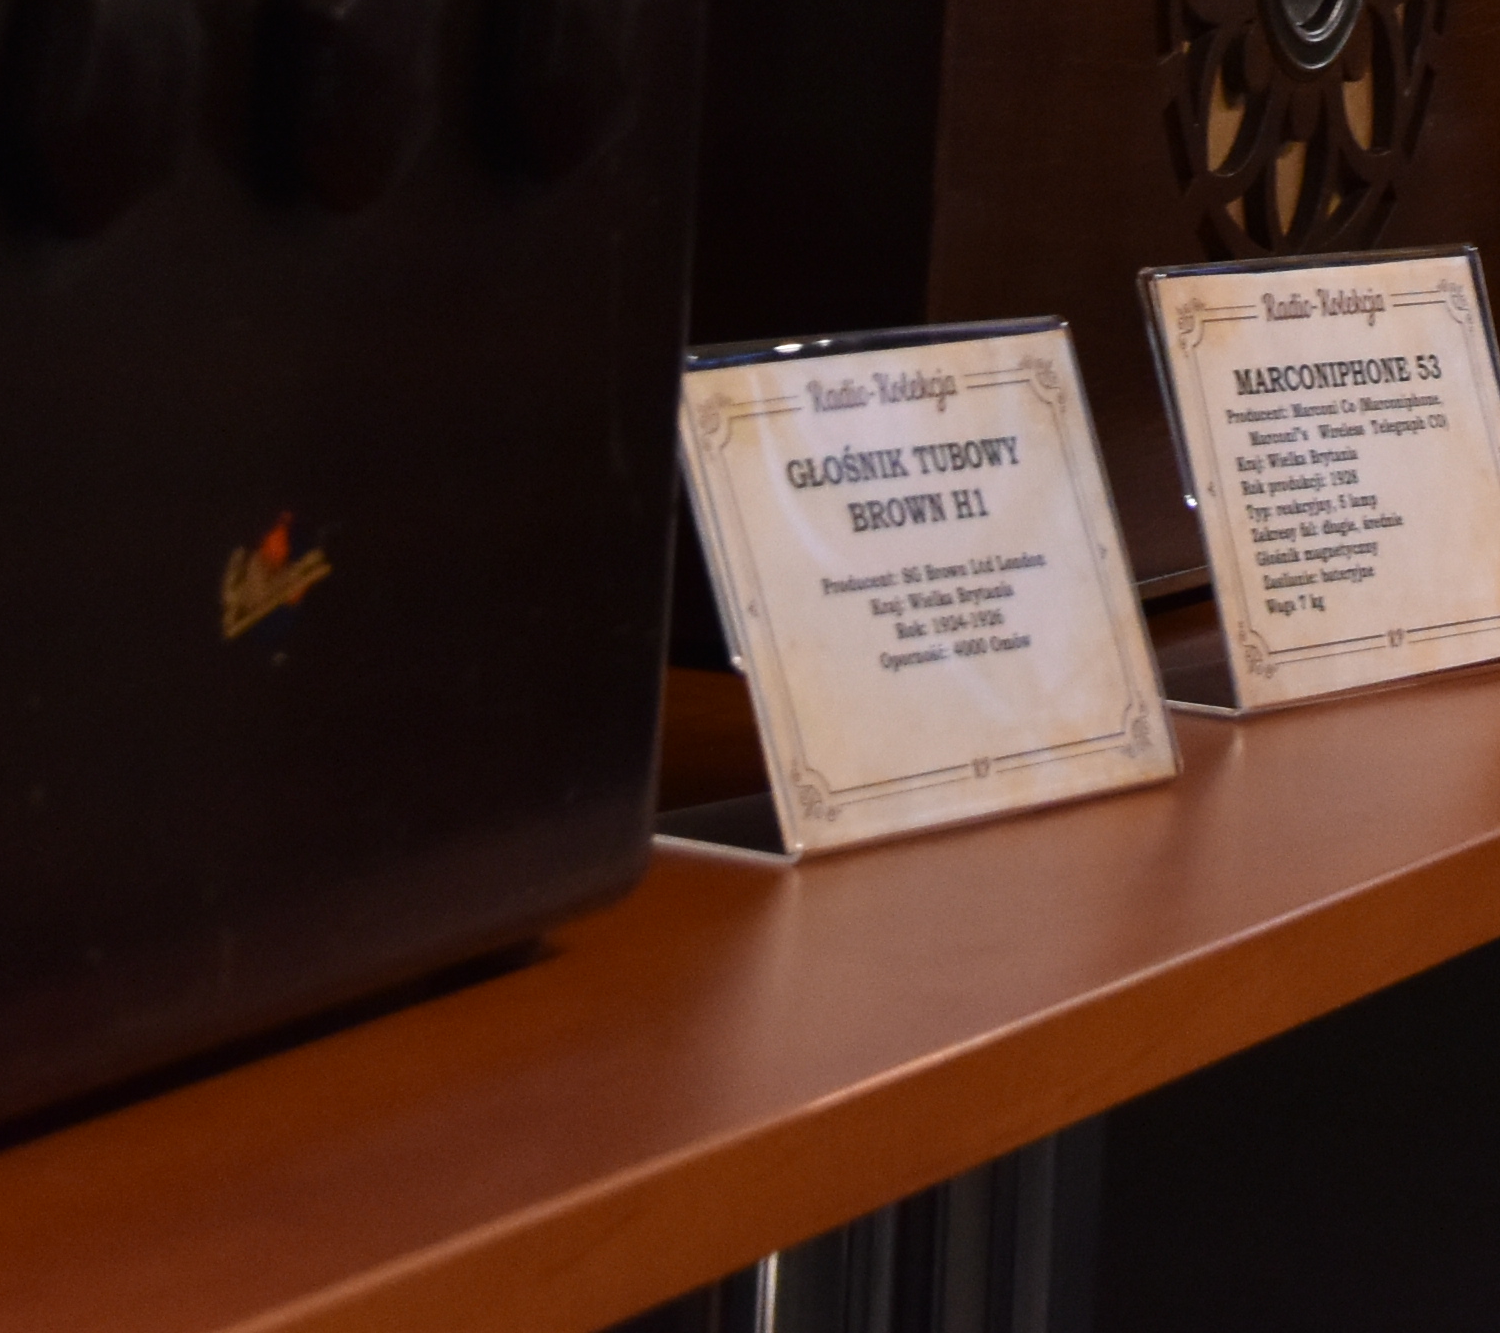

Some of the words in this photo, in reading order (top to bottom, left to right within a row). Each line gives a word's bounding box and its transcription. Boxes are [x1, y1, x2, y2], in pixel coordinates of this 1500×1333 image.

[1232, 355, 1412, 397] MARCONIPHONE
[1415, 353, 1442, 381] 53
[785, 446, 910, 491] GŁOŚNIK
[911, 435, 1020, 476] TUBOWY
[846, 492, 947, 534] BROWN
[950, 488, 990, 520] H1
